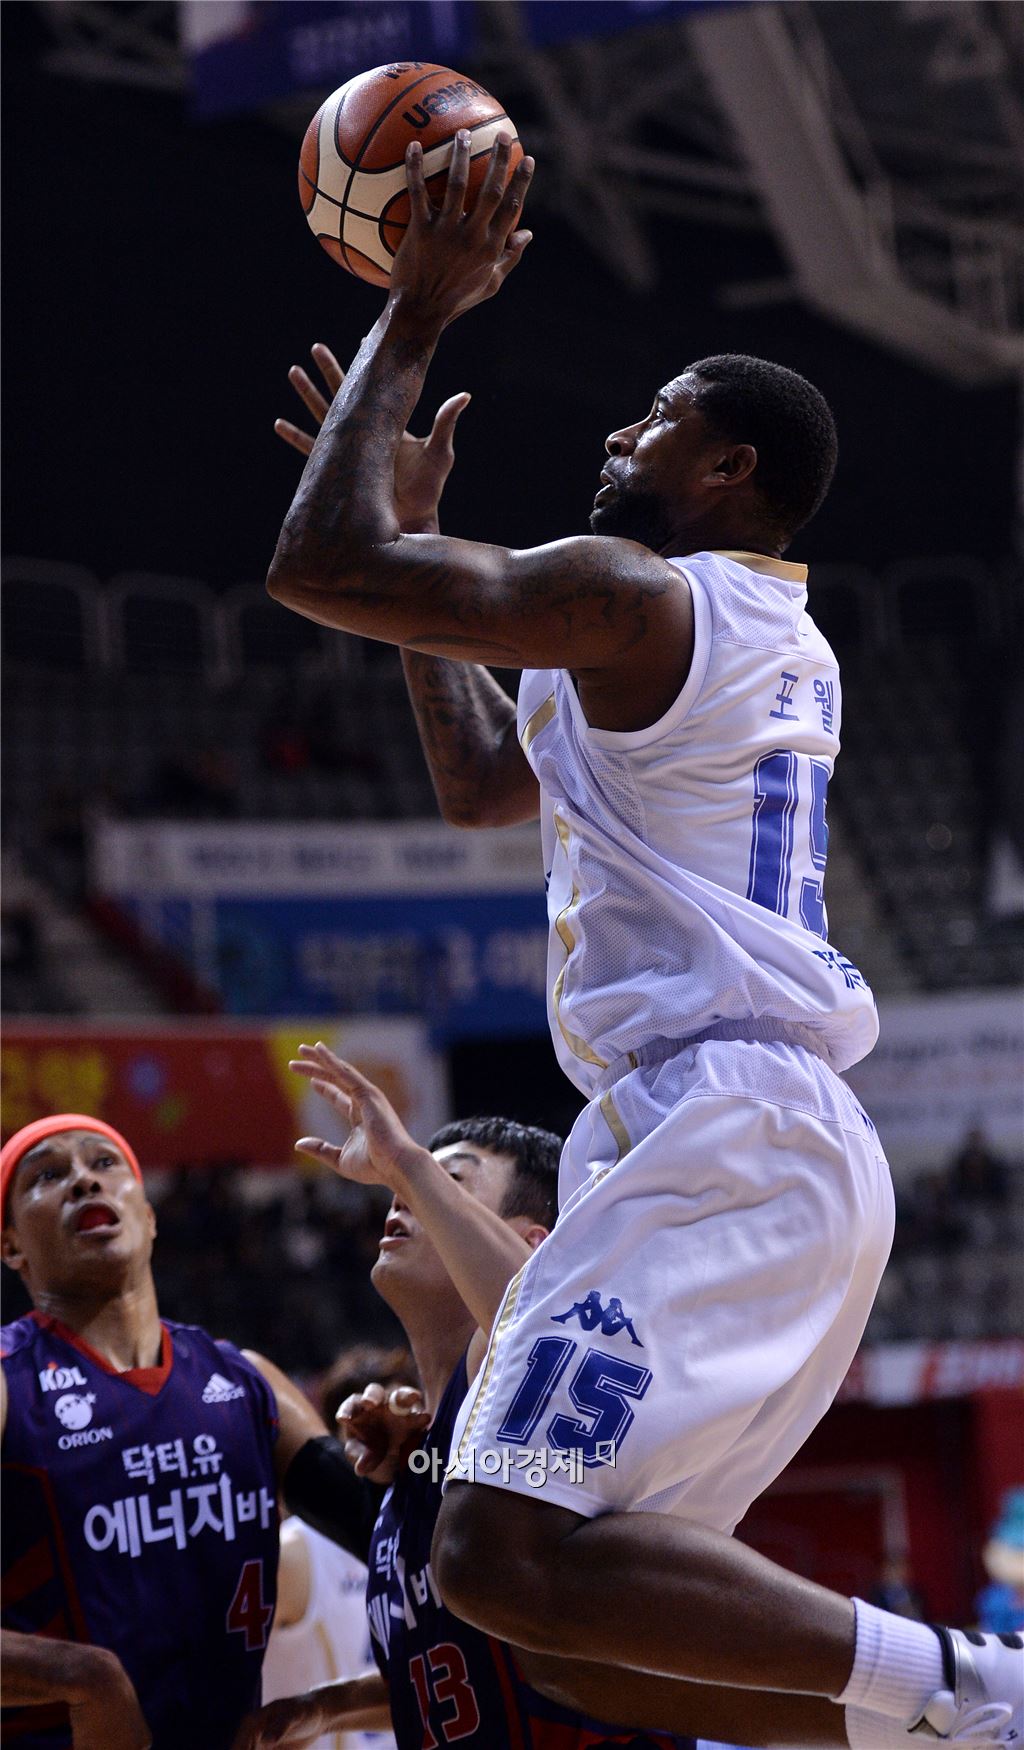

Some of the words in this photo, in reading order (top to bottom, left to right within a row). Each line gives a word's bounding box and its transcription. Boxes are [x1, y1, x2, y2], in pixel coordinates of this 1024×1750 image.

[58, 1426, 113, 1450] ORION
[495, 1335, 653, 1469] 15
[83, 1472, 274, 1558] 에너지바
[226, 1559, 273, 1652] 4
[408, 1642, 481, 1750] 13
